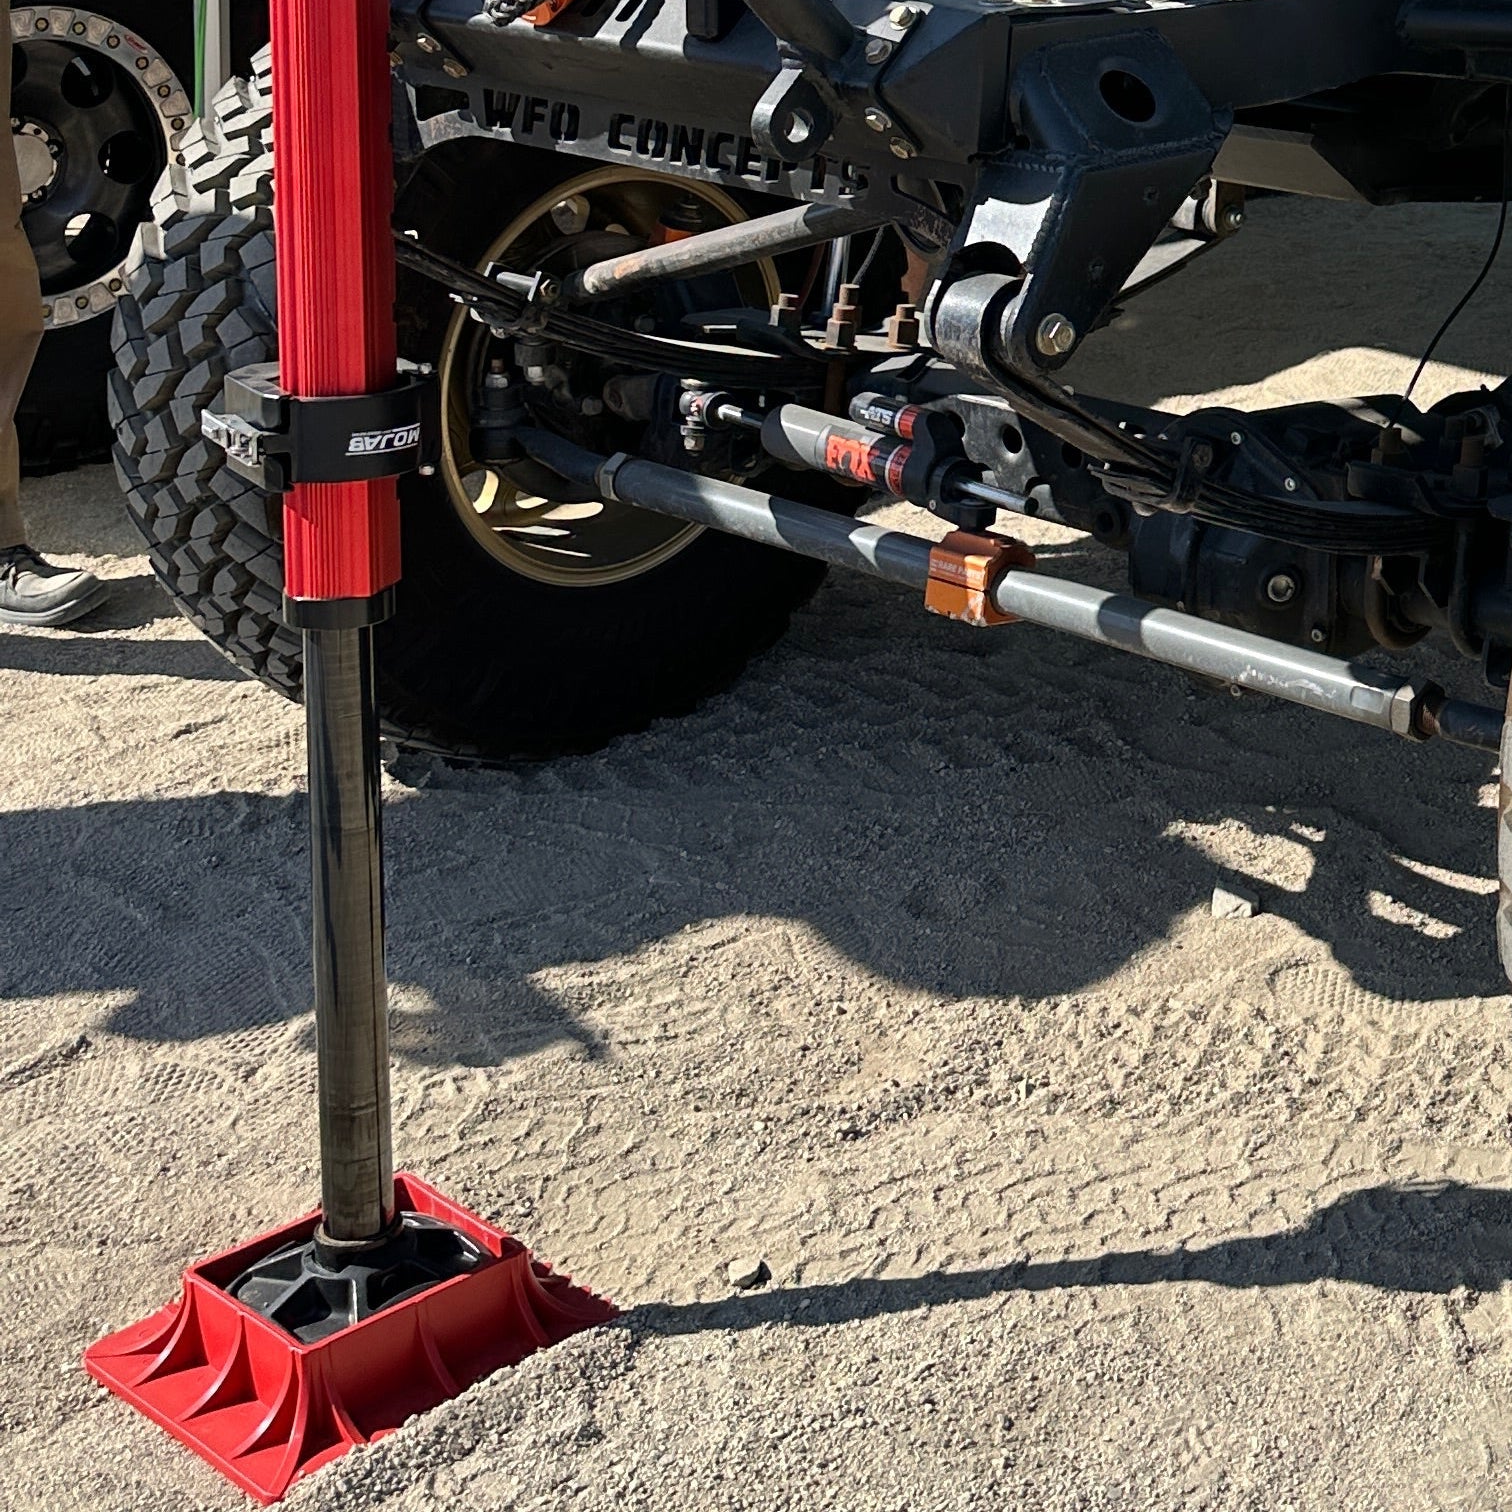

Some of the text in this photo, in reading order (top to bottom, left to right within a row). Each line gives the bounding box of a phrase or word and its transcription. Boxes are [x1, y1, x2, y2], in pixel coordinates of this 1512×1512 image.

[482, 87, 870, 199] WFO CONCEPTS
[348, 426, 420, 452] MOJAB
[824, 434, 877, 482] FOX
